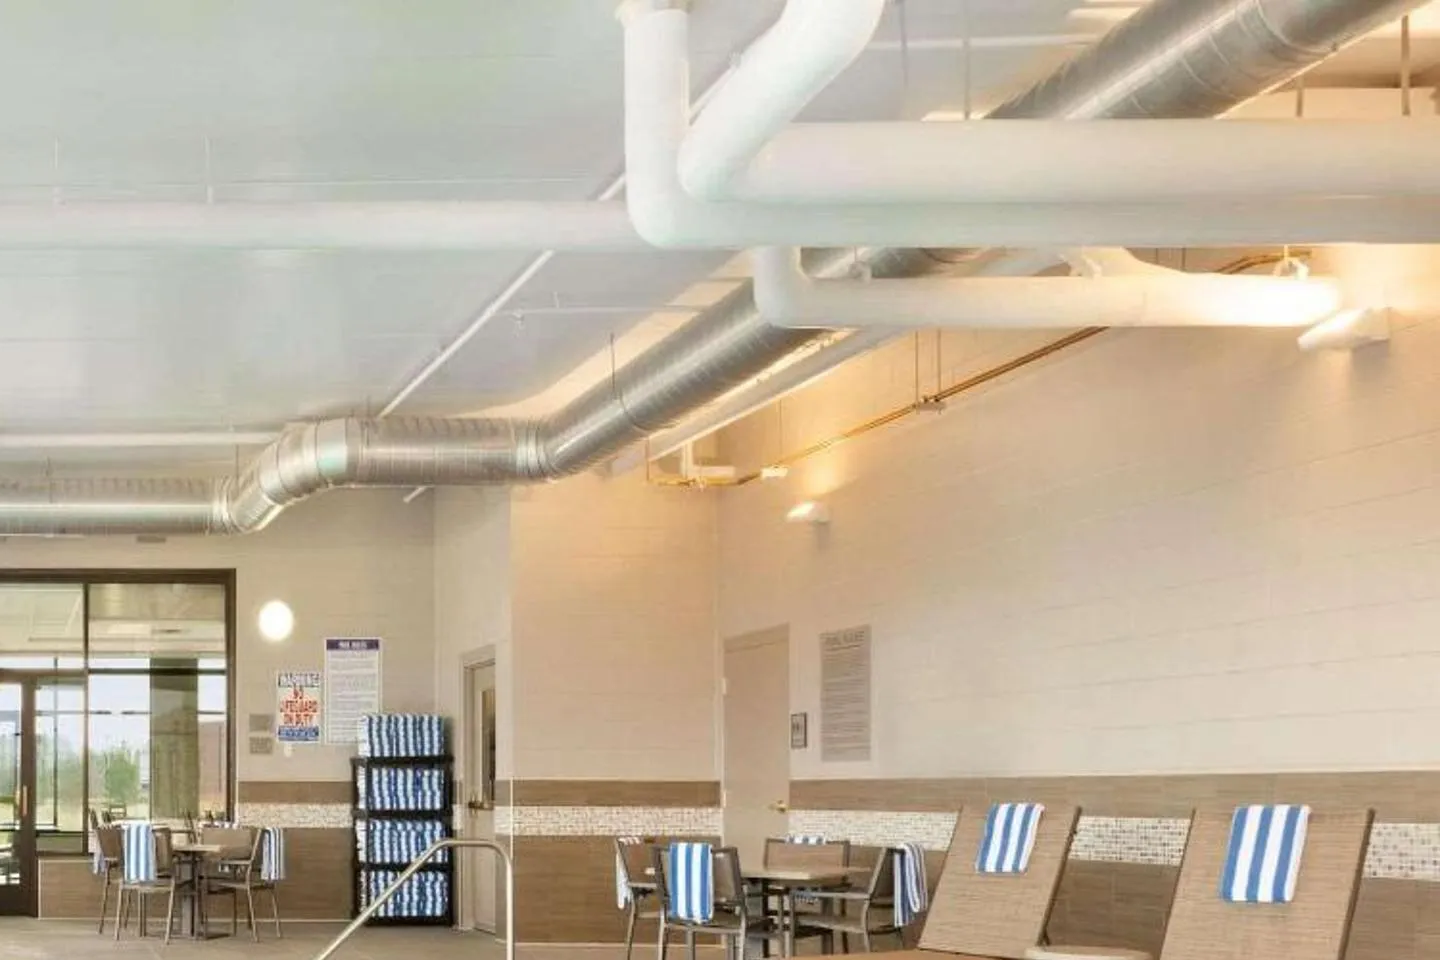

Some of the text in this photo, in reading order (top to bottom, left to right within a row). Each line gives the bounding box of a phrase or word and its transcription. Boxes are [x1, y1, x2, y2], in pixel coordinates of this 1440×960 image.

[280, 700, 318, 712] LIFEGUARD
[283, 713, 313, 725] ON DUTY
